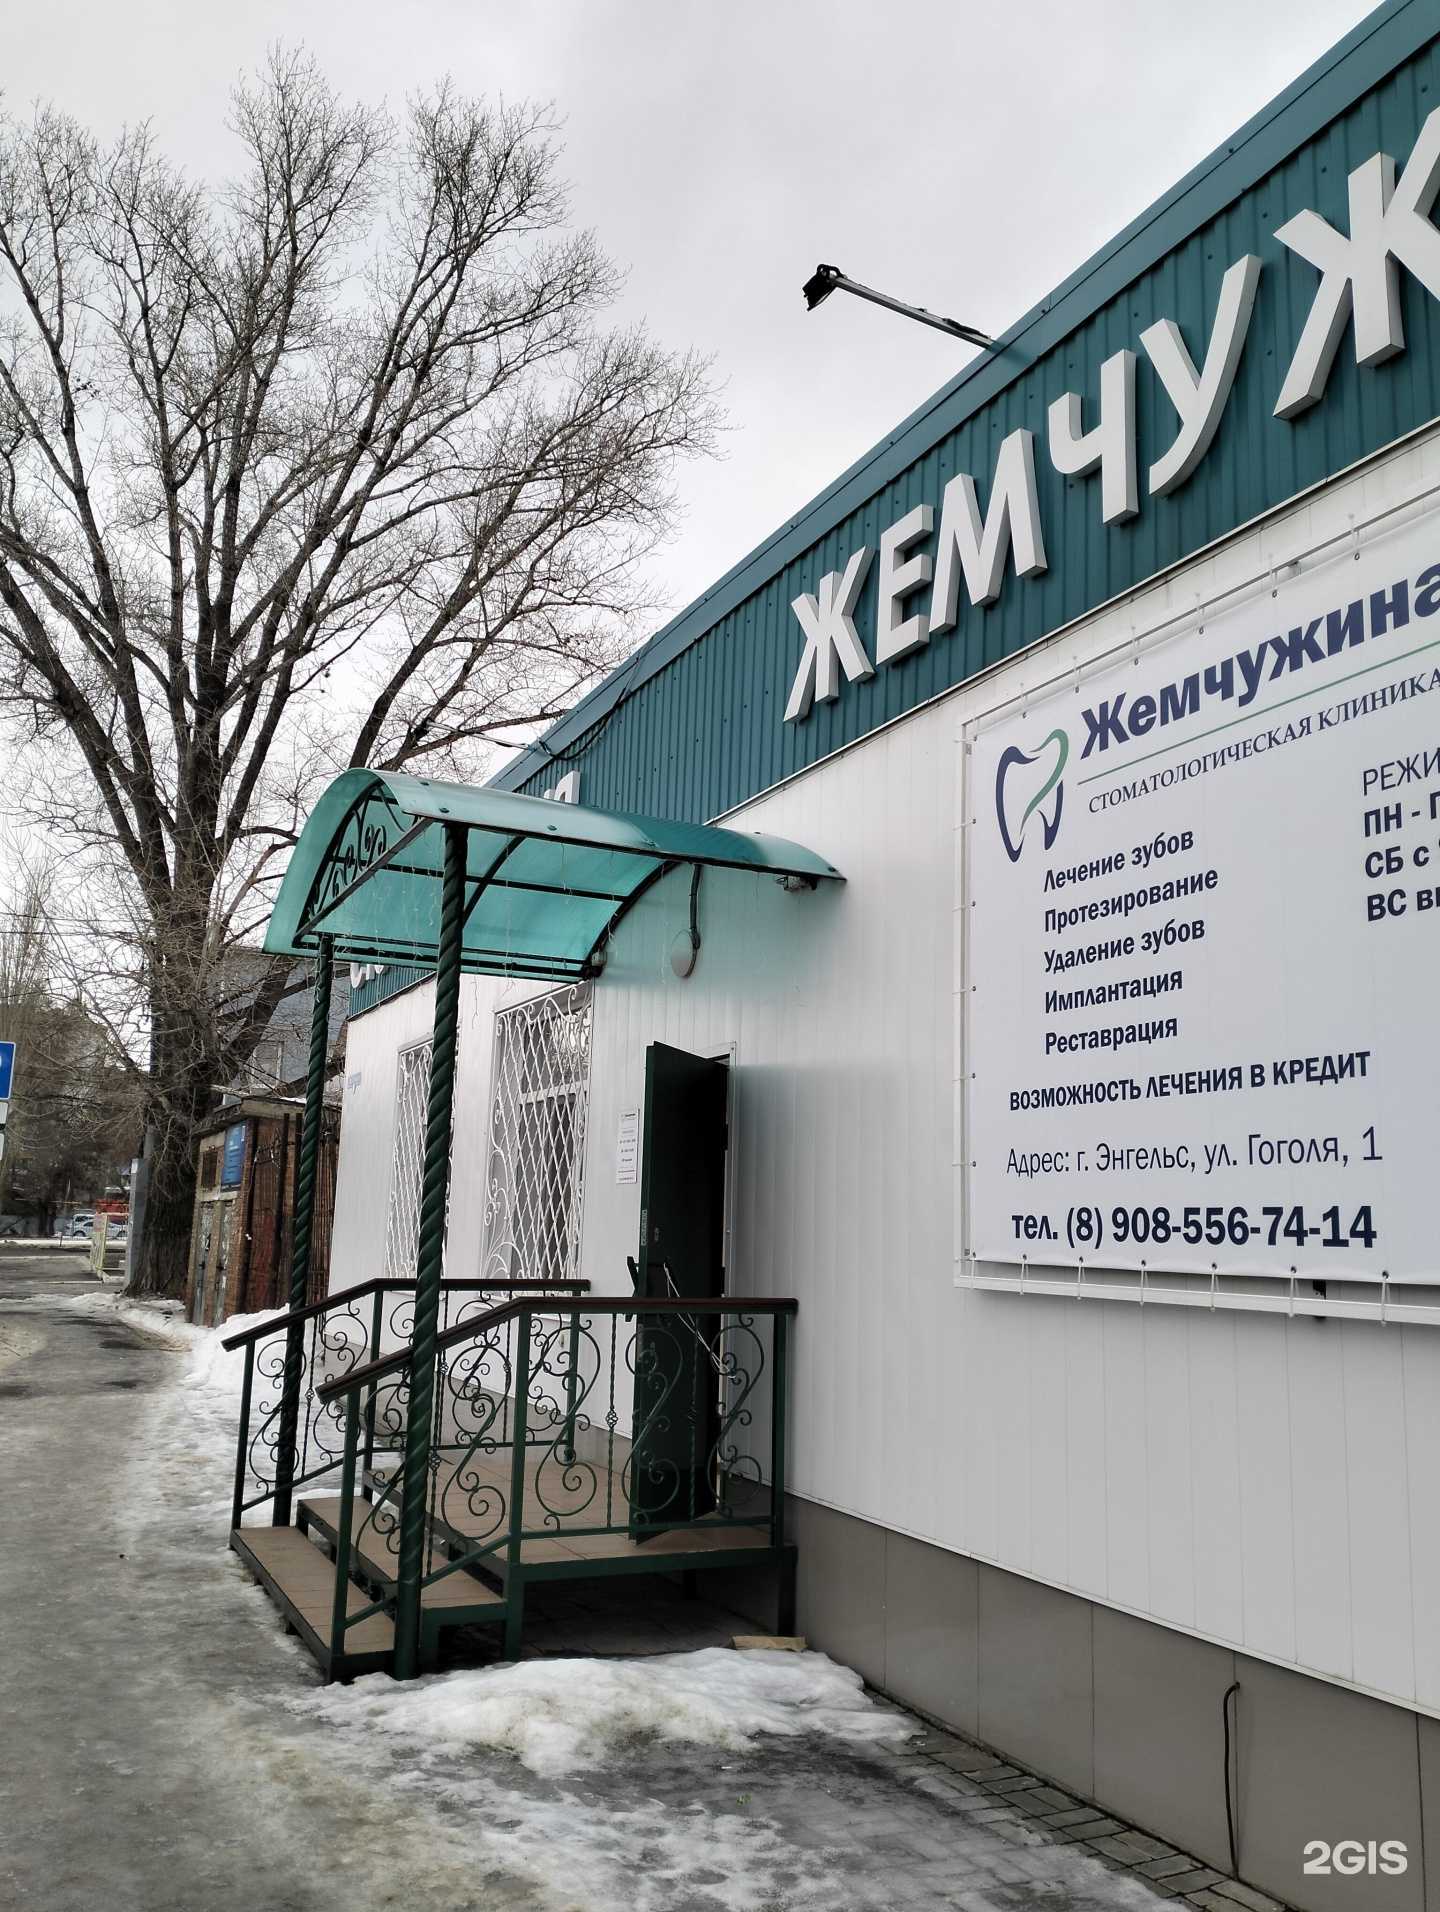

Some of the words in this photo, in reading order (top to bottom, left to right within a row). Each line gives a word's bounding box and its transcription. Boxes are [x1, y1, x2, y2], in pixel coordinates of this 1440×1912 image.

[783, 104, 1440, 723] ЖЕМЧУЖ
[1080, 562, 1440, 760] Жемчужина
[1089, 717, 1312, 814] СТОМАТОЛОГИЧЕСКАЯ
[1364, 802, 1402, 837] ПН
[1044, 852, 1125, 893] Лечение
[1131, 831, 1194, 868] зубов
[1365, 846, 1404, 878] СБ
[1413, 846, 1430, 867] с
[1044, 869, 1218, 933] Протезирование
[1367, 888, 1407, 922] ВС
[1044, 933, 1135, 973] Удаление
[1140, 919, 1205, 954] зубов
[1045, 970, 1183, 1014] Имплантация
[1045, 1018, 1178, 1055] Реставрация
[1010, 1079, 1141, 1111] ВОЗМОЖНОСТЬ
[1146, 1066, 1242, 1098] ЛЕЧЕНИЯ
[1250, 1063, 1265, 1088] В
[1273, 1051, 1371, 1086] КРЕДИТ
[1007, 1148, 1070, 1179] Адрес:
[1077, 1151, 1089, 1172] г.
[1096, 1142, 1196, 1173] Энгельс,
[1204, 1145, 1238, 1174] ул.
[1248, 1134, 1348, 1167] Гоголя,
[1362, 1126, 1382, 1161] 1
[1012, 1213, 1058, 1240] тел.
[1066, 1207, 1103, 1249] (8)
[1111, 1206, 1377, 1249] 908-556-74-14
